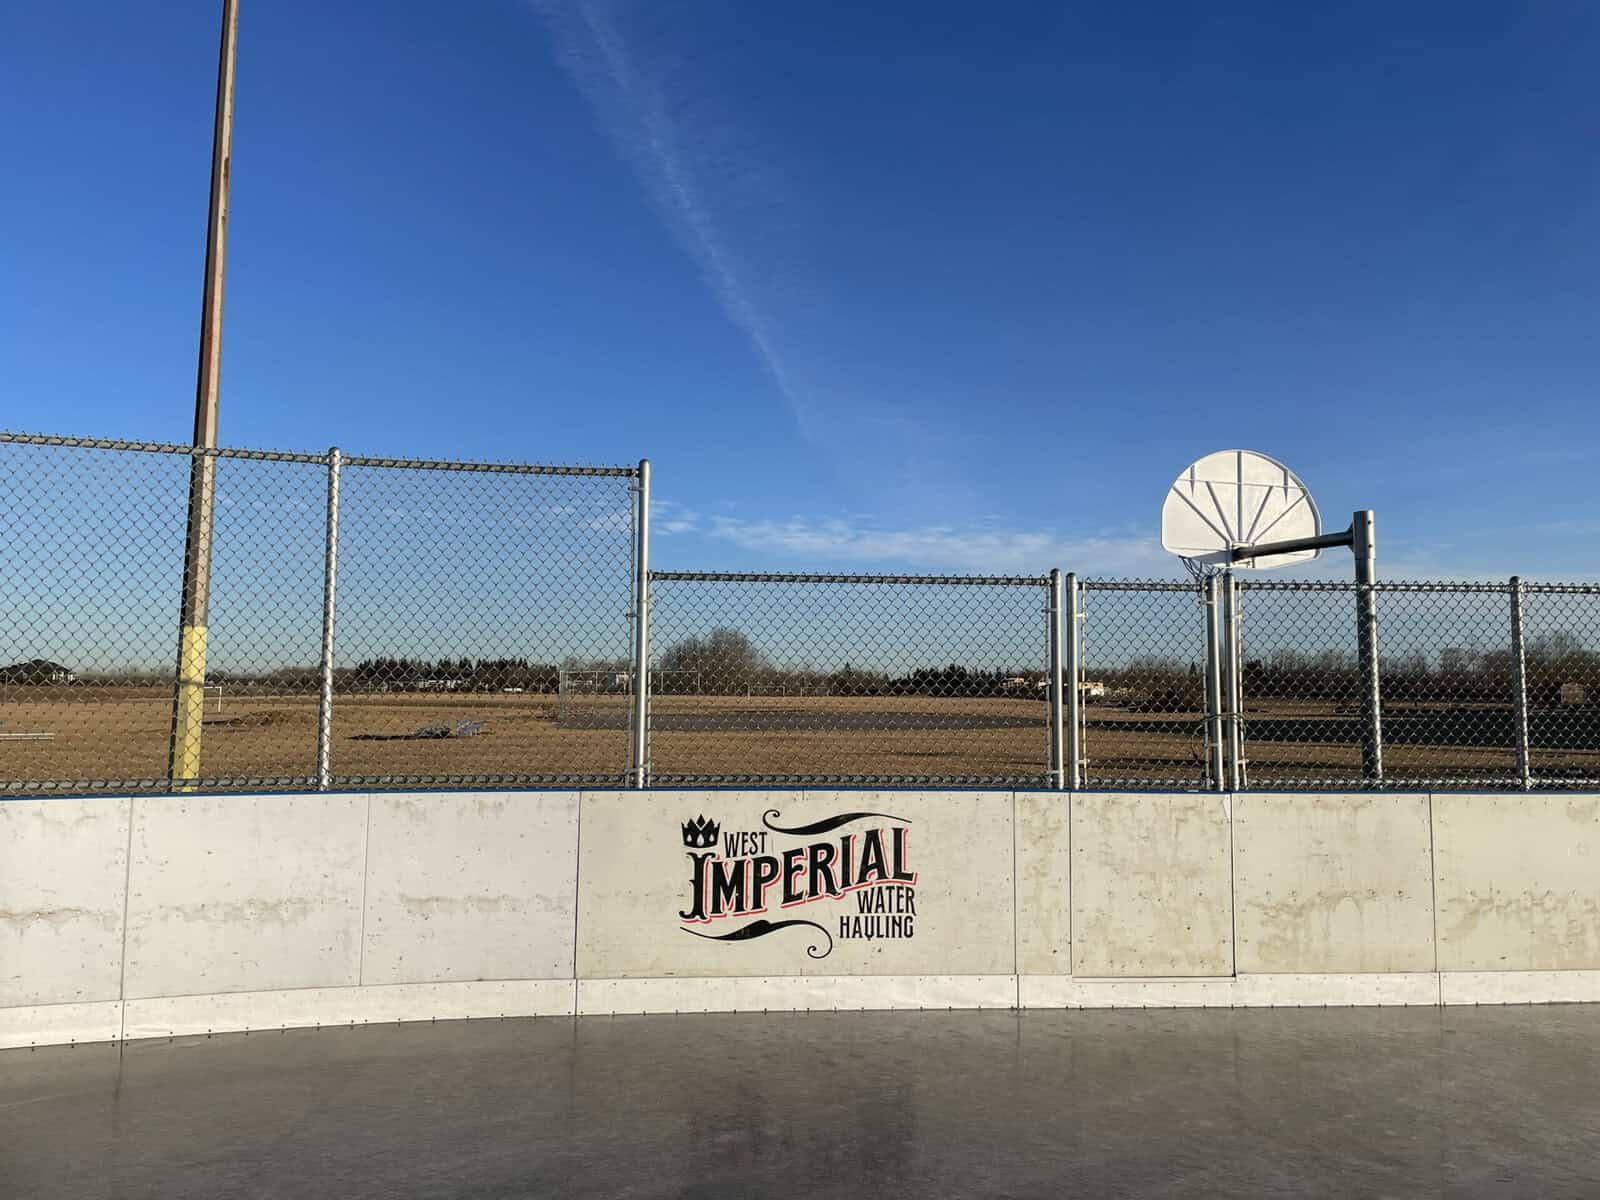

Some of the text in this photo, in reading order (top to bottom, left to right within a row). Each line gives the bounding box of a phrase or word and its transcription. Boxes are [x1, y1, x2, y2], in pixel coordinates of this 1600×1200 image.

[723, 831, 768, 858] WEST
[678, 827, 918, 923] IMPERIAL
[857, 886, 916, 916] WATER
[839, 915, 914, 941] HAULING
